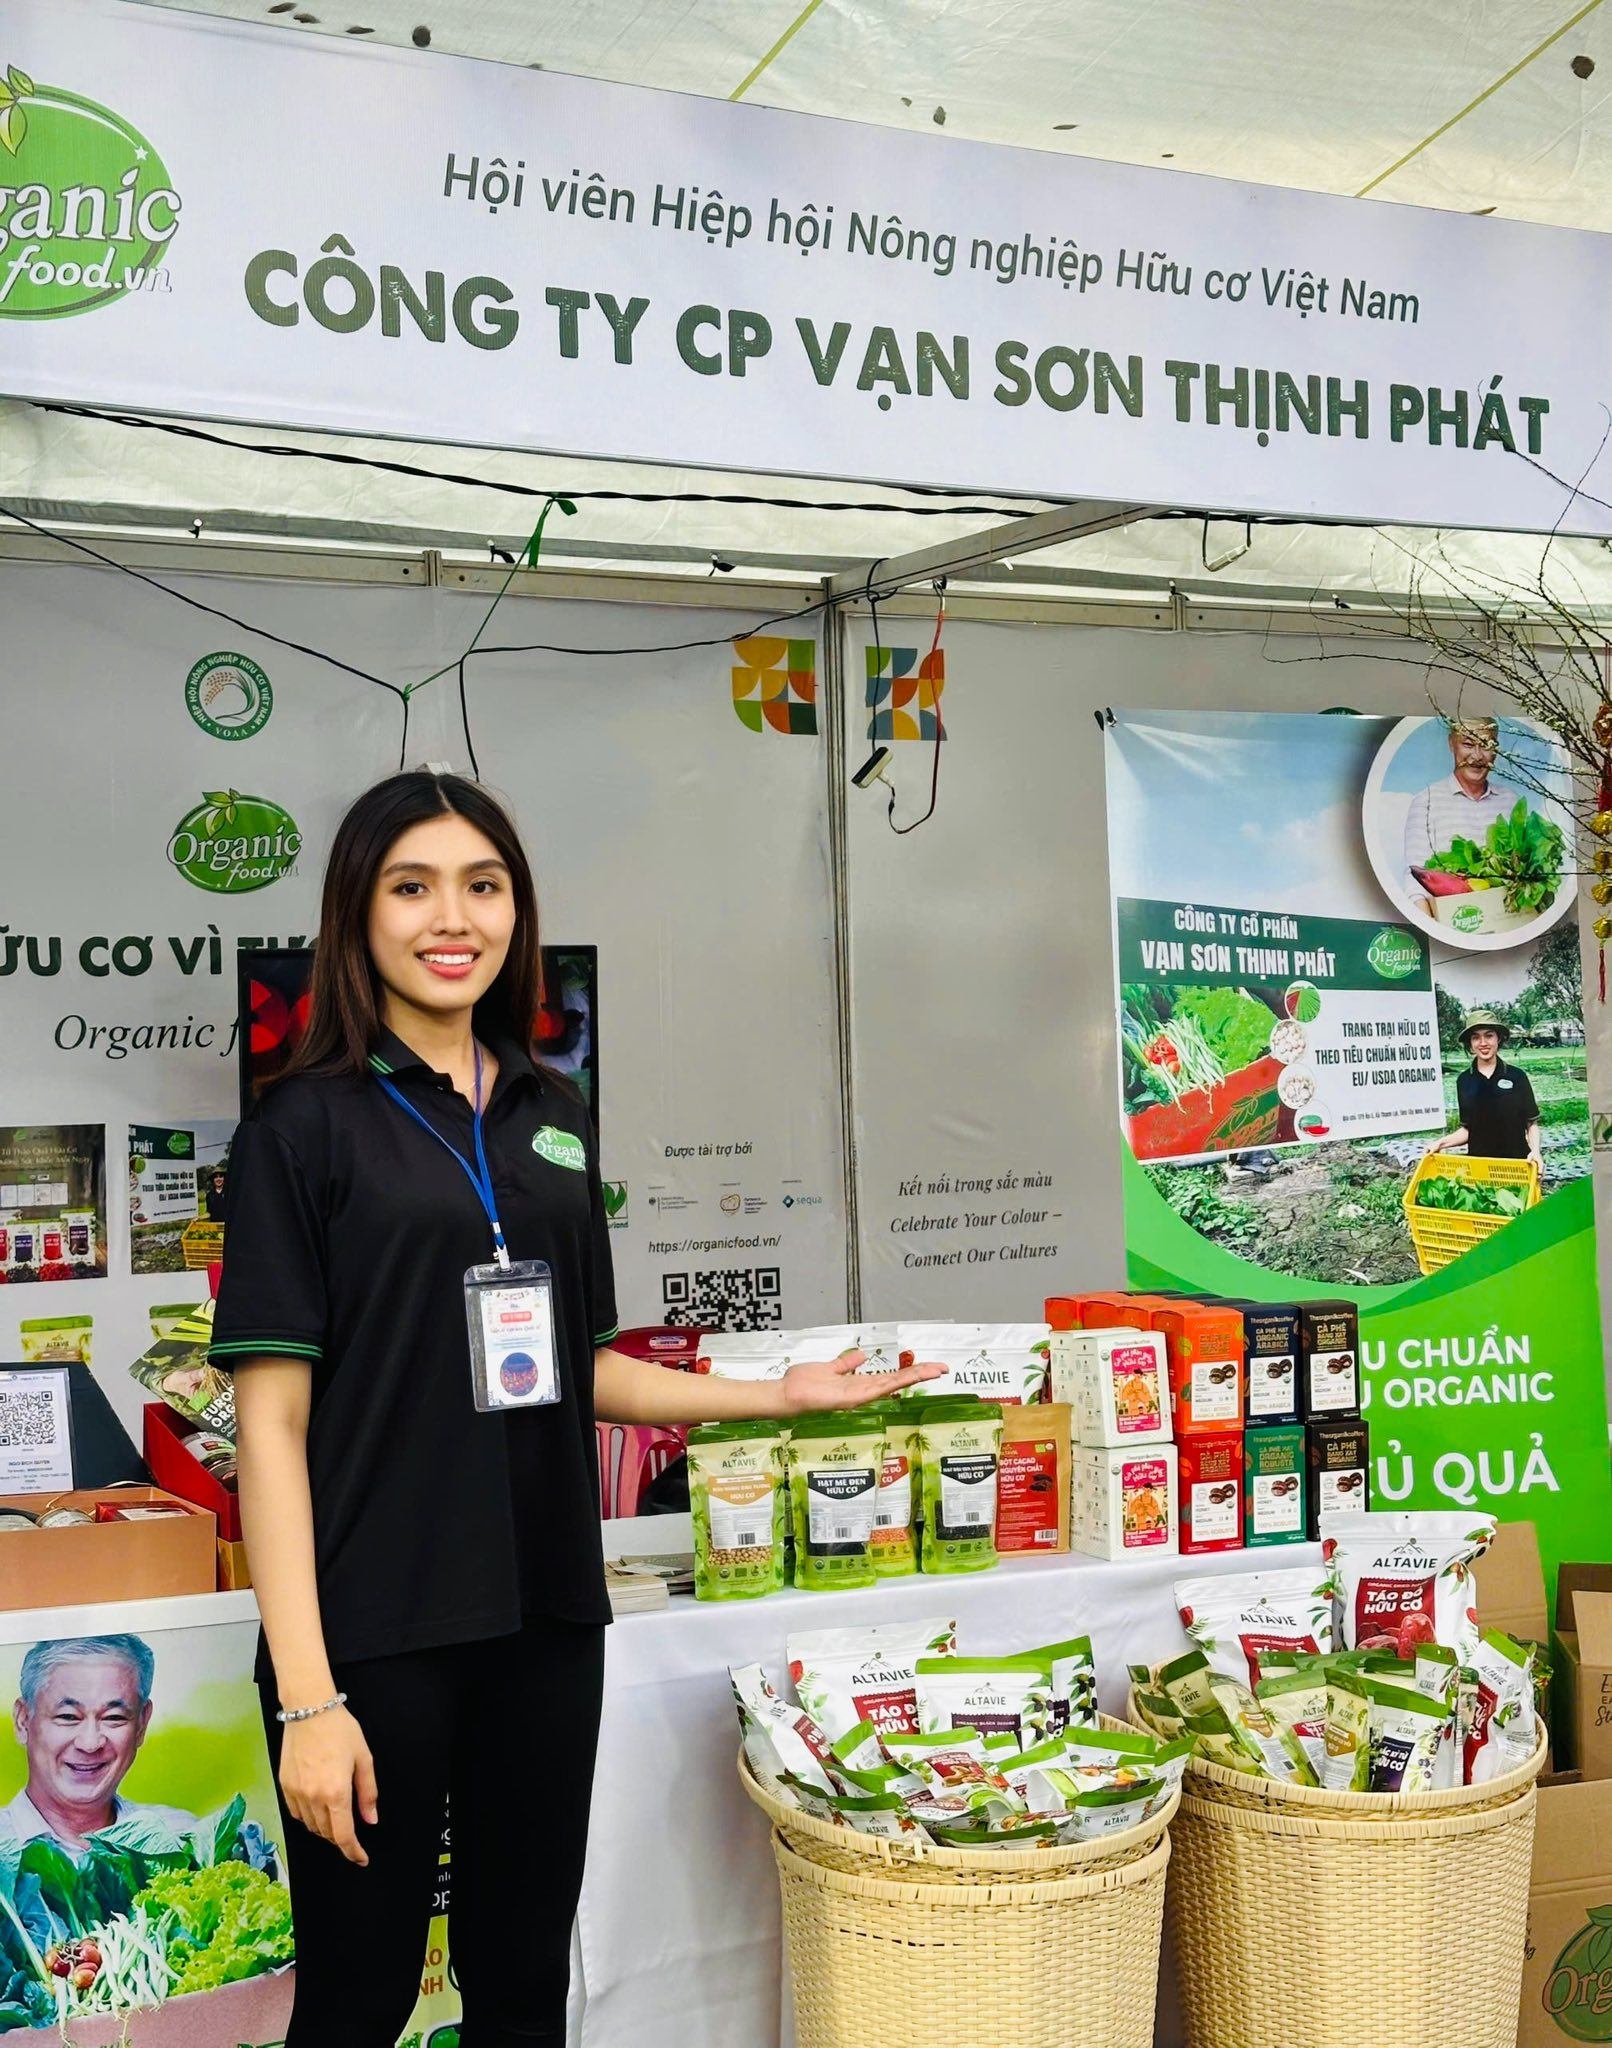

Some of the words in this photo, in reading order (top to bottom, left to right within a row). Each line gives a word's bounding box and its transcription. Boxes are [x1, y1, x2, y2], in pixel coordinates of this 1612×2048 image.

[444, 153, 524, 215] Hội
[542, 170, 635, 223] viên
[652, 184, 752, 249] Hiệp
[767, 197, 832, 259] hội
[847, 210, 957, 277] Nông
[969, 234, 1103, 294] nghiệp
[1116, 248, 1192, 296] Hữu
[1204, 269, 1250, 302] cơ
[1261, 267, 1330, 315] Việt
[1340, 277, 1420, 324] Nam
[0, 245, 173, 303] food.vn
[244, 233, 520, 351] CÔNG
[545, 286, 651, 366] TY
[675, 304, 773, 378] CP
[794, 317, 970, 412] VẠN
[993, 340, 1143, 418] SƠN
[1164, 359, 1369, 448] THỊNH
[1389, 374, 1551, 456] PHÁT
[167, 825, 303, 871] Organic
[226, 860, 300, 888] food.vn
[1174, 904, 1216, 934] CÔNG
[1219, 911, 1236, 936] TY
[1240, 911, 1260, 937] CỔ
[1263, 913, 1299, 941] PHẦN
[78, 935, 154, 977] CƠ
[168, 924, 223, 976] VÌ
[1140, 939, 1185, 977] VẠN
[1191, 943, 1231, 973] SƠN
[1236, 947, 1290, 981] THỊNH
[1294, 945, 1337, 979] PHÁT
[1367, 945, 1423, 968] Organic
[54, 1014, 216, 1060] Organic
[1342, 1022, 1374, 1039] TRANG
[1376, 1021, 1396, 1041] TRẠI
[1398, 1018, 1417, 1037] HỮU
[1418, 1018, 1430, 1037] CƠ
[1315, 1048, 1340, 1066] THEO
[1343, 1045, 1364, 1064] TIÊU
[1365, 1042, 1398, 1064] CHUẨN
[1398, 1042, 1418, 1062] HỮU
[1419, 1042, 1432, 1061] CƠ
[1352, 1070, 1369, 1088] EU/
[1372, 1069, 1398, 1087] USDA
[1399, 1066, 1437, 1084] ORGANIC
[664, 1144, 695, 1158] Được
[698, 1143, 713, 1157] tài
[716, 1144, 732, 1158] trợ
[734, 1141, 753, 1155] bởi
[898, 1175, 921, 1197] Kết
[927, 1173, 950, 1195] nối
[954, 1177, 993, 1195] trong
[996, 1169, 1019, 1191] sắc
[1022, 1171, 1053, 1190] màu
[890, 1214, 959, 1234] Celebrate
[963, 1212, 998, 1229] Your
[1001, 1208, 1049, 1226] Colour
[648, 1235, 782, 1255] https://organicfood.vn/
[904, 1250, 962, 1269] Connect
[967, 1248, 996, 1264] Our
[999, 1243, 1058, 1261] Cultures
[1398, 1324, 1531, 1370] CHUẨN
[954, 1371, 1010, 1386] ALTAVIE
[1383, 1372, 1556, 1409] ORGANIC
[950, 1438, 979, 1448] ALTAVIE
[722, 1457, 757, 1469] ALTAVIE
[821, 1452, 858, 1462] ALTAVIE
[1432, 1432, 1561, 1506] QUẢ
[1372, 1556, 1439, 1569] ALTAVIE
[1366, 1589, 1399, 1603] TÁO
[1401, 1585, 1424, 1600] ĐỎ
[1363, 1599, 1397, 1615] HỮU
[1399, 1597, 1423, 1612] CƠ
[1240, 1613, 1298, 1627] ALTAVIE
[851, 1668, 915, 1686] ALTAVIE
[867, 1703, 903, 1720] TÁO
[964, 1696, 1006, 1707] ALTAVIE
[873, 1717, 910, 1736] HỮU
[866, 1826, 889, 1835] ALTAVIE
[1103, 1815, 1130, 1827] ALTAVIE
